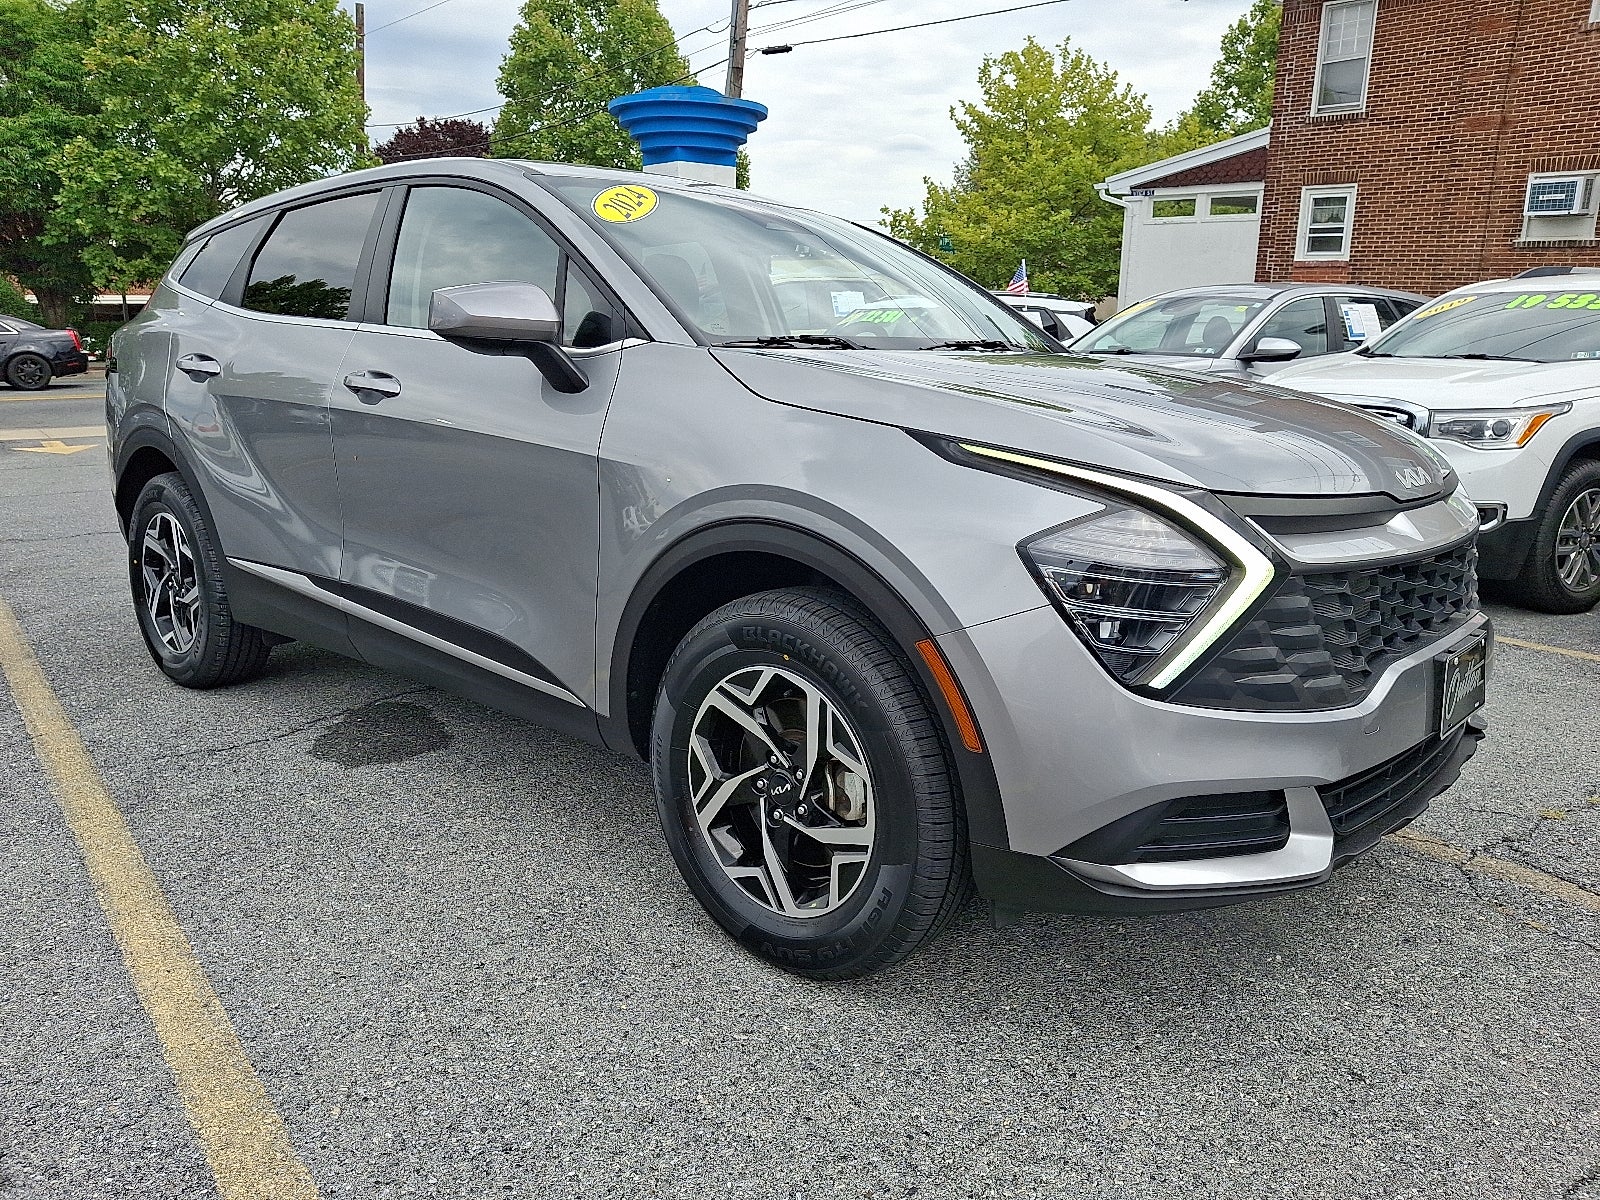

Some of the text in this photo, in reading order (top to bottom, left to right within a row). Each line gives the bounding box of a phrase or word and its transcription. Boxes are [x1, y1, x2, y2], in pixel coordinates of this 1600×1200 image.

[602, 186, 649, 220] 2024
[742, 626, 870, 709] BLACKHAWK
[770, 783, 791, 796] KIA
